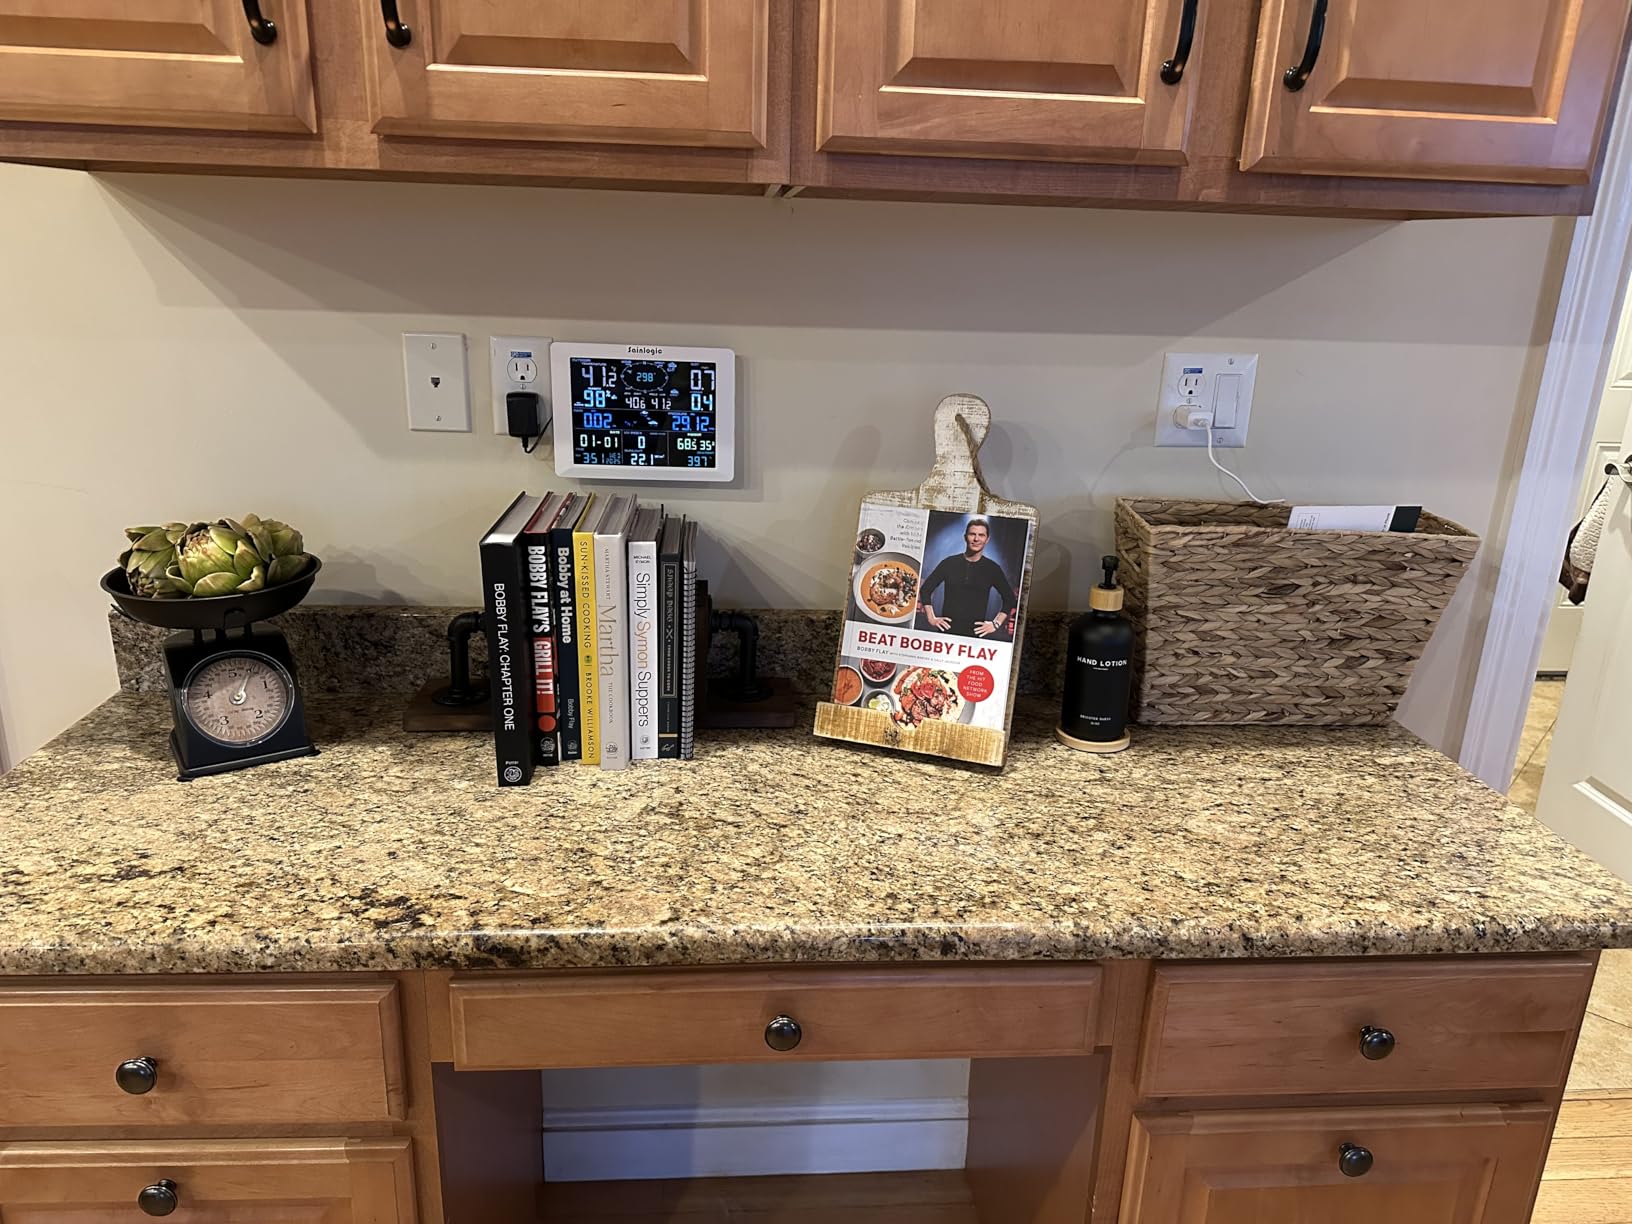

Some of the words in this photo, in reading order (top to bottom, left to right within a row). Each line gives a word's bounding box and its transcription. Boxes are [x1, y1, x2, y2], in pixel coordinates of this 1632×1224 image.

[628, 346, 662, 356] Sainlogic
[690, 370, 714, 390] 0.7
[690, 393, 713, 411] 0.4
[638, 436, 646, 449] 0
[528, 546, 548, 588] BOBBY
[557, 547, 572, 588] Bobby
[580, 541, 590, 598] SUN-KISSED
[494, 584, 508, 622] BOBBY
[560, 590, 572, 604] at
[634, 572, 650, 618] Simply
[530, 592, 550, 632] FLAY'S
[561, 606, 572, 644] Home
[582, 602, 592, 648] COOKING
[497, 624, 510, 652] FLAY:
[599, 604, 619, 676] Martha
[634, 621, 650, 668] Symon
[858, 630, 896, 646] BEAT
[900, 636, 954, 654] BOBBY
[958, 644, 998, 660] FLAY
[228, 668, 237, 678] 5
[534, 641, 552, 676] GRILL
[1077, 656, 1098, 666] HAND
[203, 690, 212, 698] 4
[264, 680, 268, 689] 1
[500, 654, 513, 706] CHAPTER
[536, 678, 554, 694] IT!
[254, 710, 263, 718] 2
[636, 671, 651, 727] Suppers
[220, 716, 230, 726] 3
[504, 708, 515, 731] ONE
[586, 708, 594, 758] WILLIAMSON
